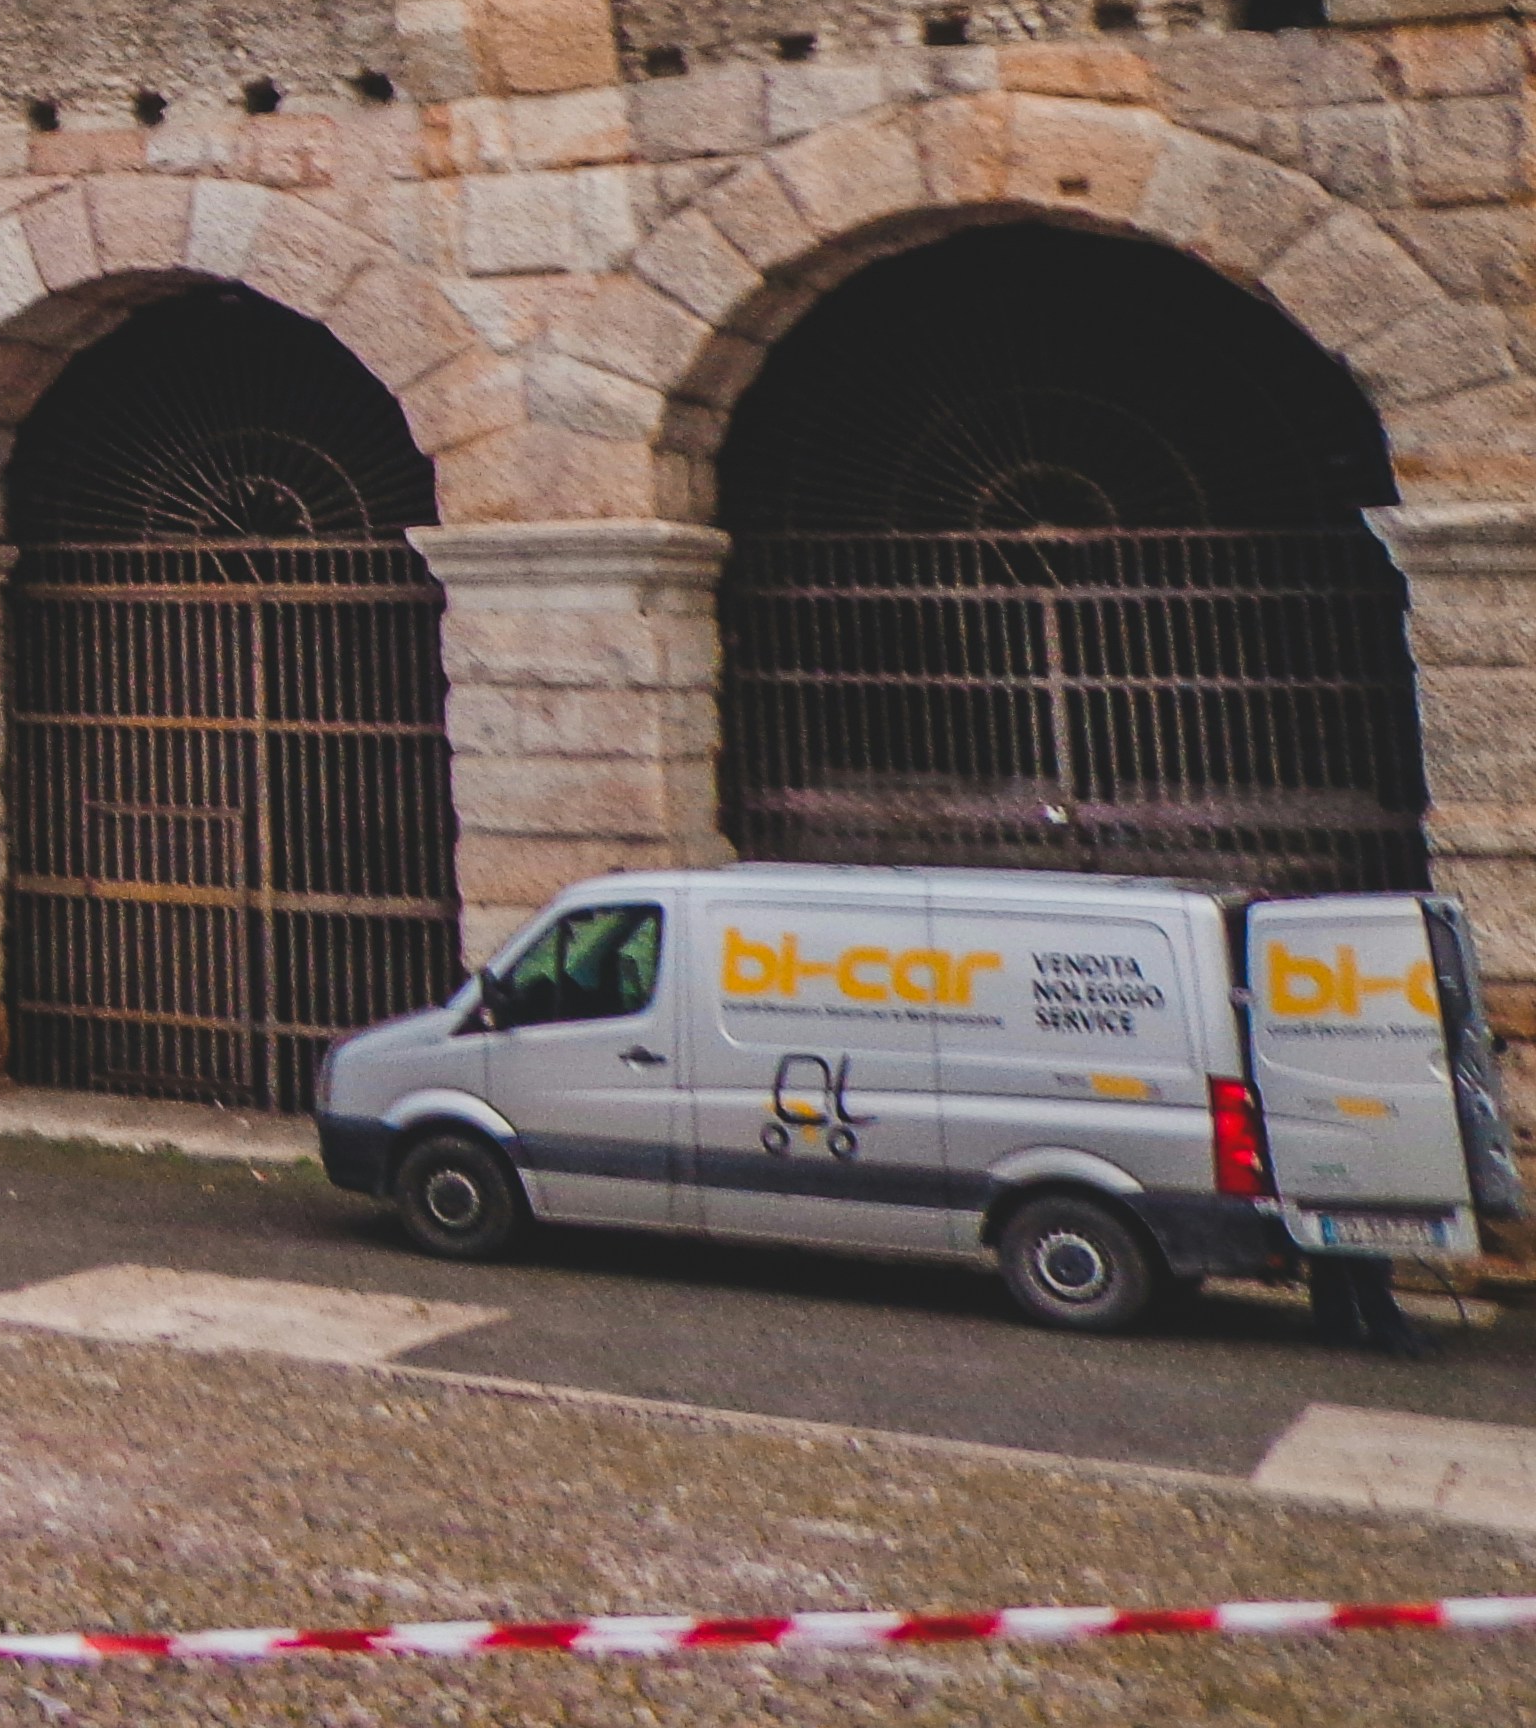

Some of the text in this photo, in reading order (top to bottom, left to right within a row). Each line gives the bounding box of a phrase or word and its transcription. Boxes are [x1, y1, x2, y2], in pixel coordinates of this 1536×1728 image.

[722, 926, 1003, 1006] bi-car
[1032, 952, 1144, 981] VENDITA
[1032, 979, 1165, 1009] NOLEGGIO
[1035, 1005, 1137, 1037] SERVICE
